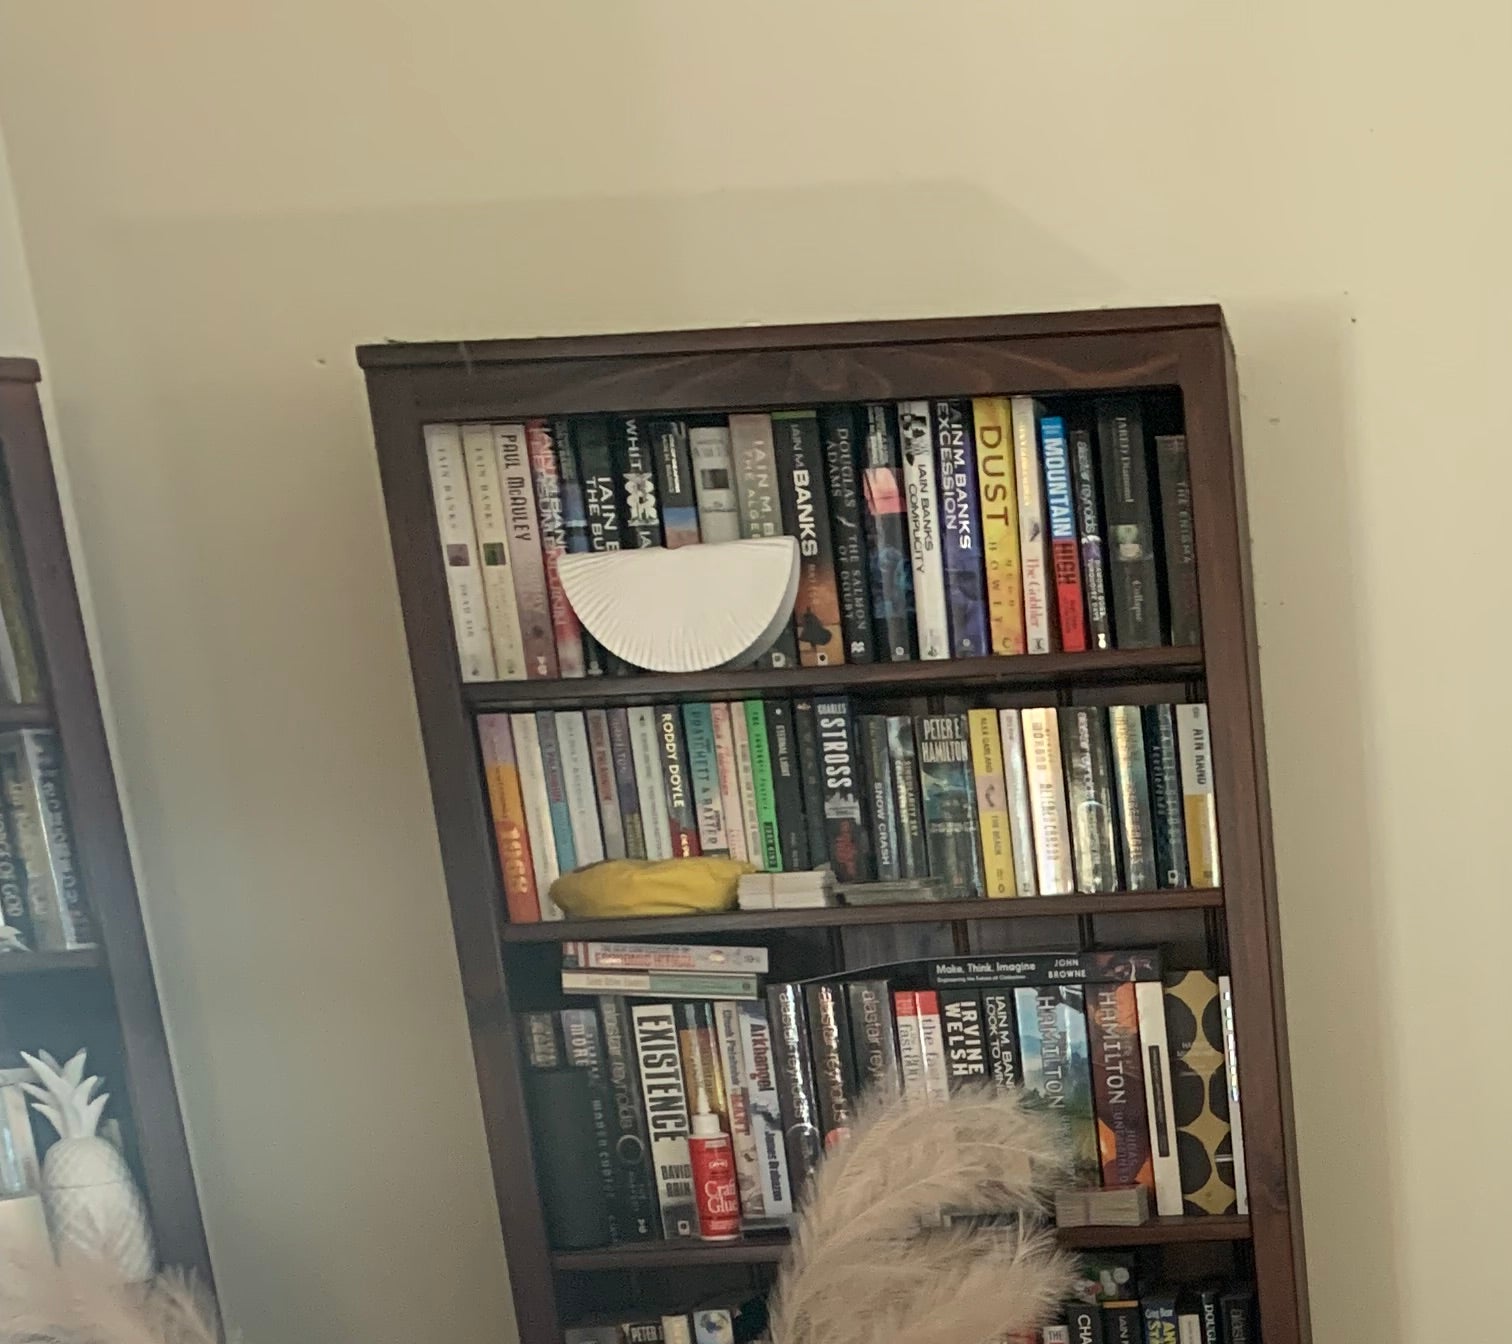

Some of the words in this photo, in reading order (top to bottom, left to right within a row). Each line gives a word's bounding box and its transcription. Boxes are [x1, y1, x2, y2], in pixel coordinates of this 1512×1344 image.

[501, 434, 518, 469] PAUL
[626, 419, 643, 471] WHIT
[754, 440, 770, 488] IAIN
[791, 424, 803, 453] IAIN
[826, 440, 842, 497] ADAMS
[837, 428, 857, 508] DOUGLAS
[918, 464, 930, 494] IAIN
[937, 402, 958, 530] EXCESSION
[979, 425, 1009, 527] DUST
[1043, 438, 1072, 537] MOUNTAIN
[506, 476, 532, 541] McAULEY
[586, 476, 599, 518] THE
[598, 477, 617, 531] IAIN
[793, 469, 818, 557] BANKS
[955, 476, 972, 549] BANKS
[1175, 482, 1187, 504] THE
[848, 536, 860, 563] THE
[908, 484, 925, 574] COMPLICITY
[921, 497, 934, 551] BANKS
[1054, 542, 1076, 585] HIGH
[840, 569, 855, 619] DOUBT
[851, 570, 867, 631] SALMON
[661, 713, 679, 761] RODDY
[820, 718, 851, 790] STROSS
[922, 741, 968, 762] HAMILTON
[924, 719, 952, 740] PETER
[669, 765, 685, 808] DOYLE
[690, 710, 710, 781] PRATCHETT
[700, 800, 718, 845] BAXTER
[873, 782, 887, 818] SNOW
[875, 821, 890, 866] CRASH
[936, 965, 965, 975] Make.
[967, 962, 994, 974] Think.
[996, 961, 1036, 974] Imagine
[1048, 969, 1087, 979] BROWNE
[1054, 958, 1079, 967] JOHN
[605, 1003, 624, 1058] alastair
[778, 993, 797, 1046] alastair
[818, 990, 839, 1048] alastair
[861, 990, 880, 1043] alastair
[922, 1019, 936, 1045] the
[945, 1003, 968, 1076] WELSH
[961, 1001, 984, 1075] IRVINE
[986, 997, 998, 1036] LOOK
[995, 997, 1008, 1030] IAIN
[750, 1023, 775, 1092] Arkhangel
[991, 1040, 1001, 1059] TO
[1037, 996, 1065, 1108] HAMILTON
[1099, 992, 1126, 1104] HAMILTON
[611, 1062, 635, 1130] reynolds
[636, 1015, 688, 1142] EXISTENCE
[785, 1052, 807, 1119] reynolds
[660, 1164, 691, 1181] DAVID
[707, 1197, 739, 1214] Glue
[1049, 1331, 1062, 1341] THE
[1118, 1315, 1128, 1338] IAIN
